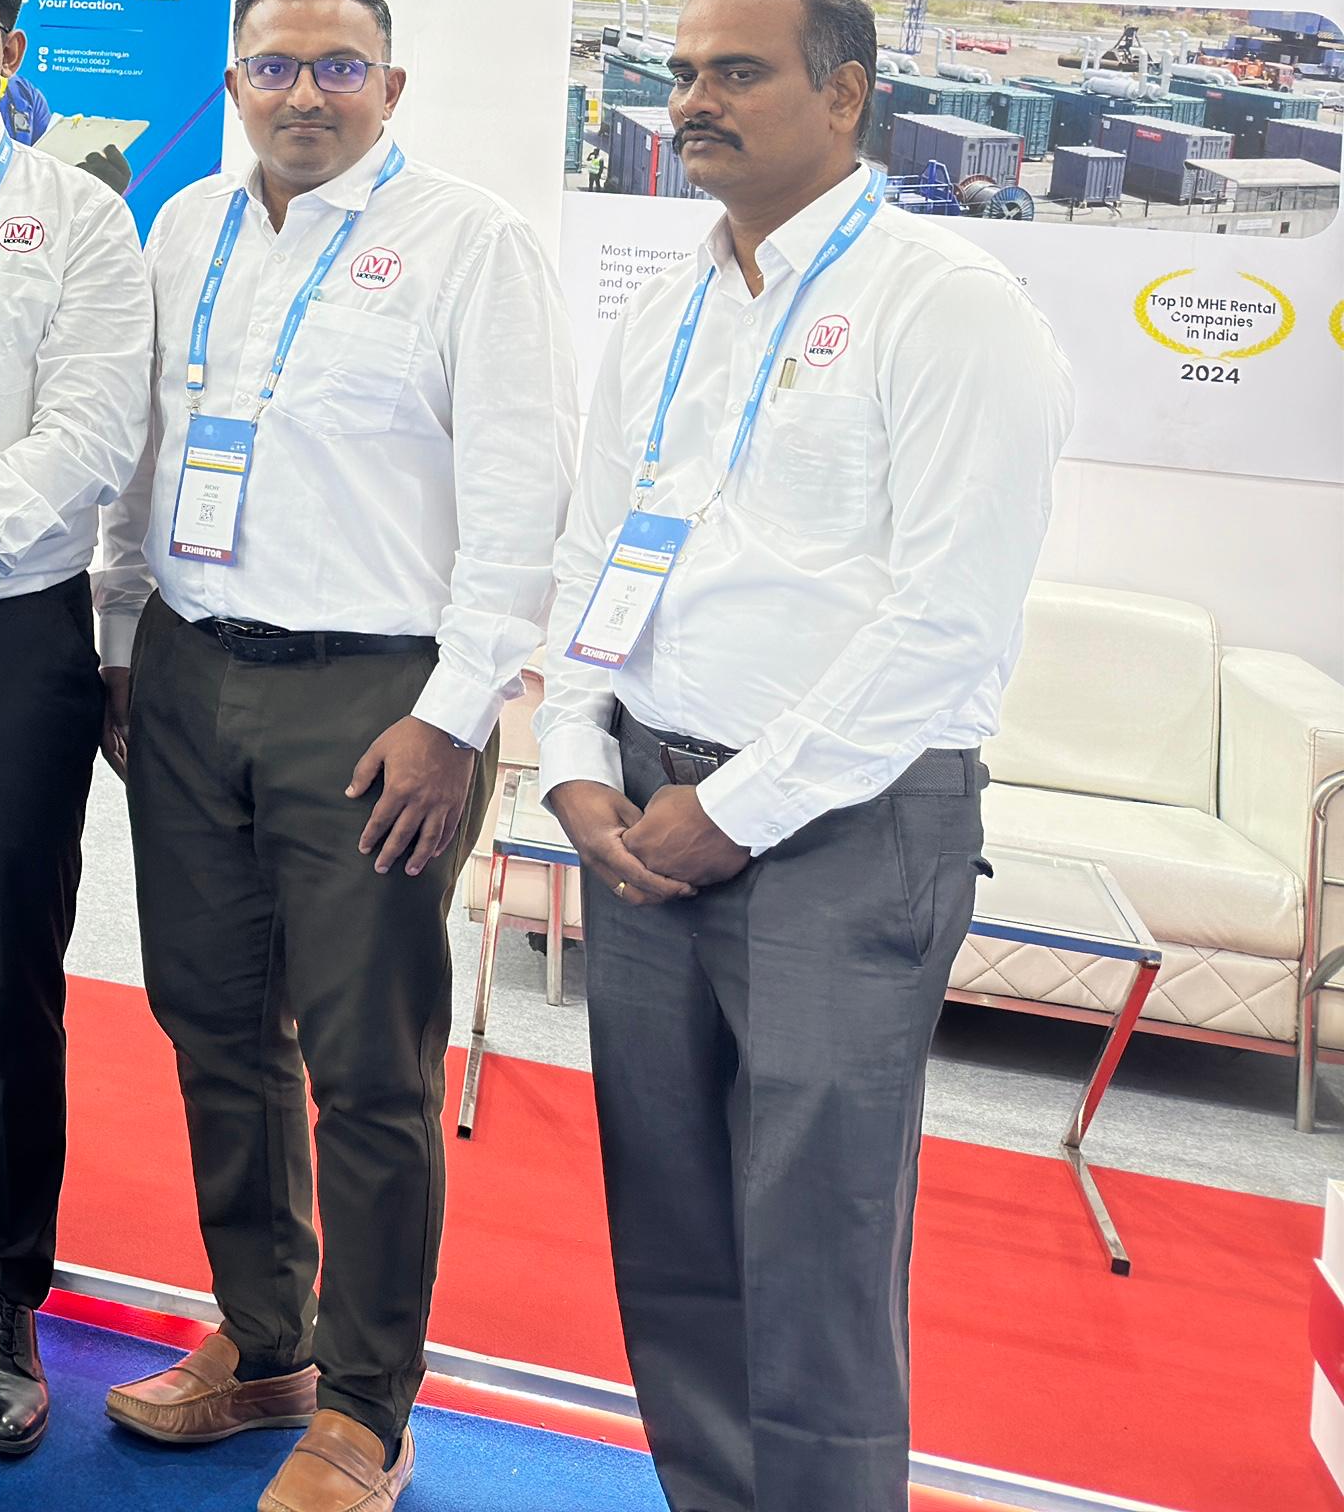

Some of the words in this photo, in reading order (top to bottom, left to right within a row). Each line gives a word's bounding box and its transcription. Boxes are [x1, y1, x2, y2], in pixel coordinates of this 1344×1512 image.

[38, 0, 67, 10] your
[69, 0, 124, 11] location.
[601, 245, 632, 257] Most
[600, 260, 633, 275] bring
[356, 271, 386, 284] MODERN
[599, 277, 623, 288] and
[1150, 294, 1176, 310] Top
[1180, 296, 1194, 309] 10
[1197, 298, 1227, 312] MHE
[1230, 300, 1276, 315] Rental
[1171, 311, 1253, 328] Companies
[1186, 326, 1200, 339] in
[1203, 328, 1239, 342] India
[1180, 364, 1241, 385] 2024
